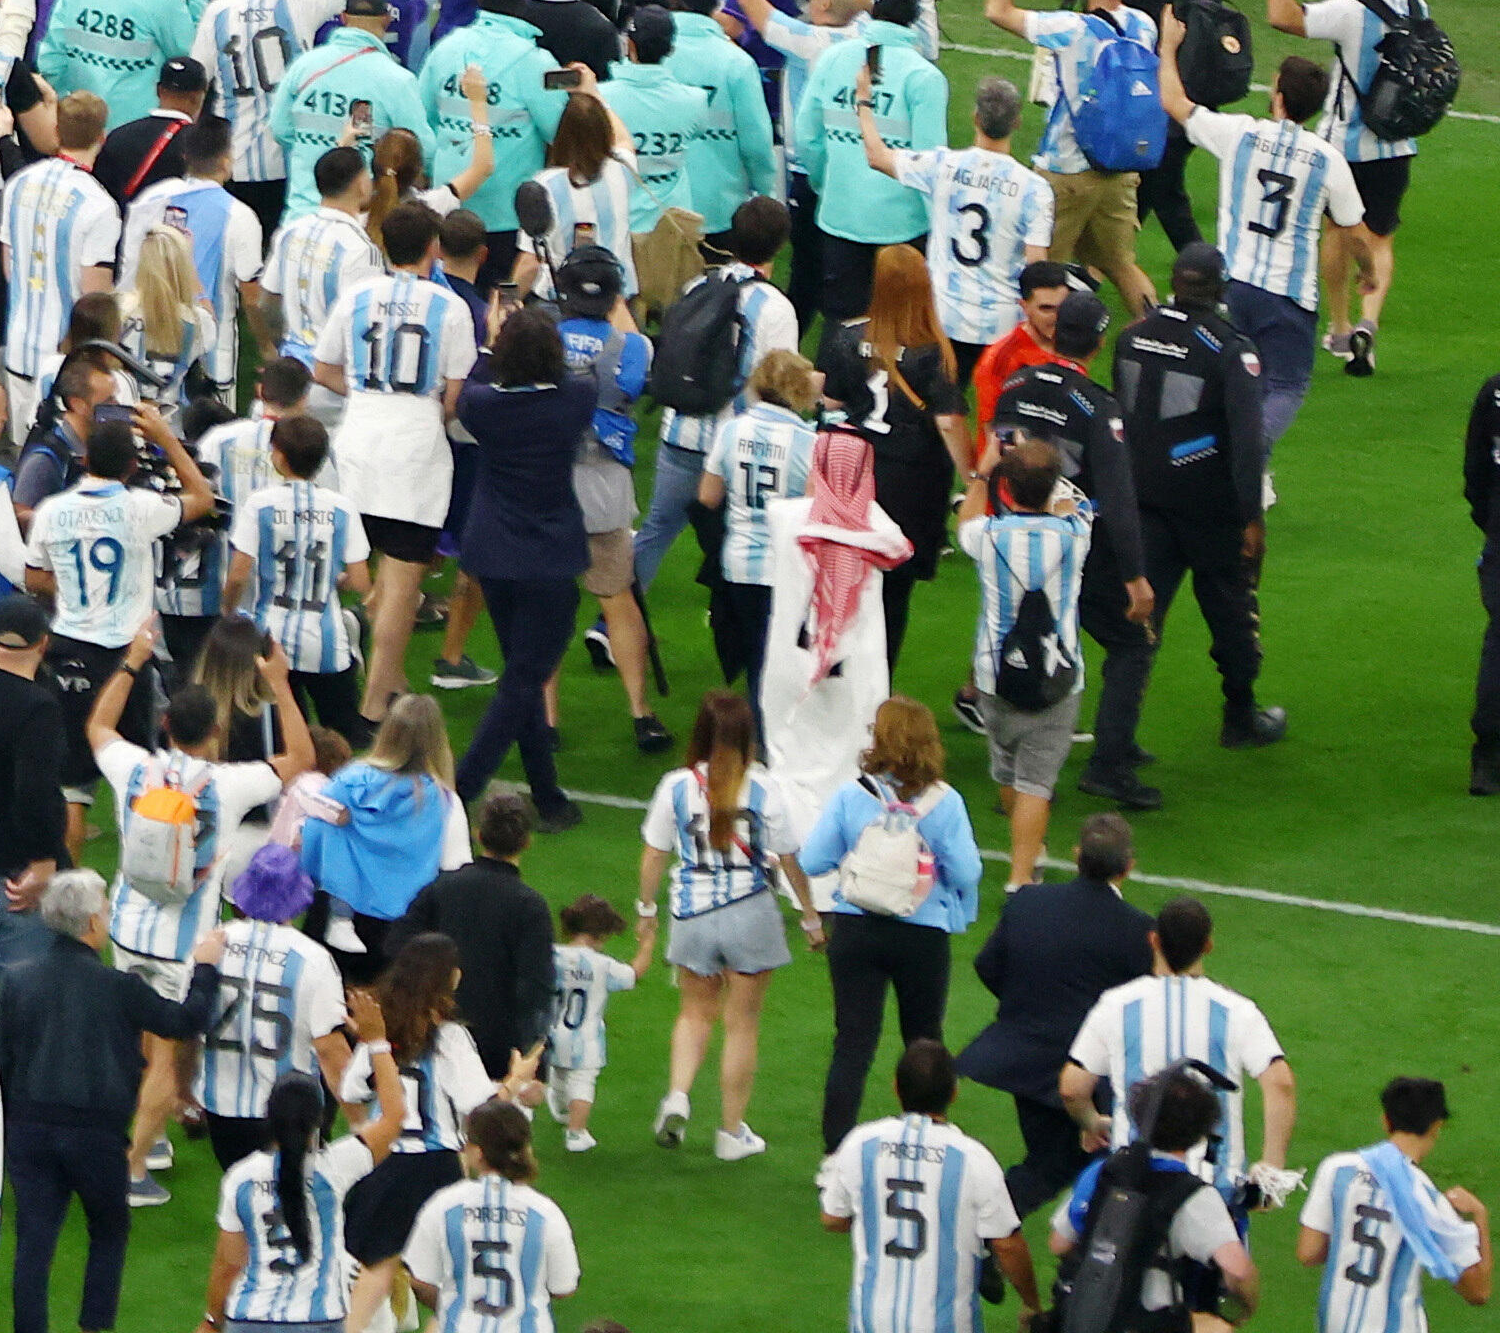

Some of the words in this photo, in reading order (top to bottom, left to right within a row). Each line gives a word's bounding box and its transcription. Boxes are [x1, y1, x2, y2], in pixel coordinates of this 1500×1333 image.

[76, 10, 134, 39] 4288
[225, 27, 285, 98] 10
[304, 92, 348, 117] 413
[947, 164, 1017, 196] TAGLIAFICO
[1248, 169, 1295, 237] 3
[951, 203, 990, 265] 3
[569, 335, 603, 349] FIFA
[736, 461, 781, 509] 12
[272, 509, 290, 526] DI
[295, 509, 335, 527] MARIA
[68, 537, 123, 608] 19
[207, 976, 293, 1061] 25
[881, 1142, 945, 1164] PAREDES
[463, 1206, 526, 1227] PAREDES
[884, 1177, 929, 1260] 5
[1346, 1203, 1392, 1287] 5
[472, 1240, 516, 1315] 5
